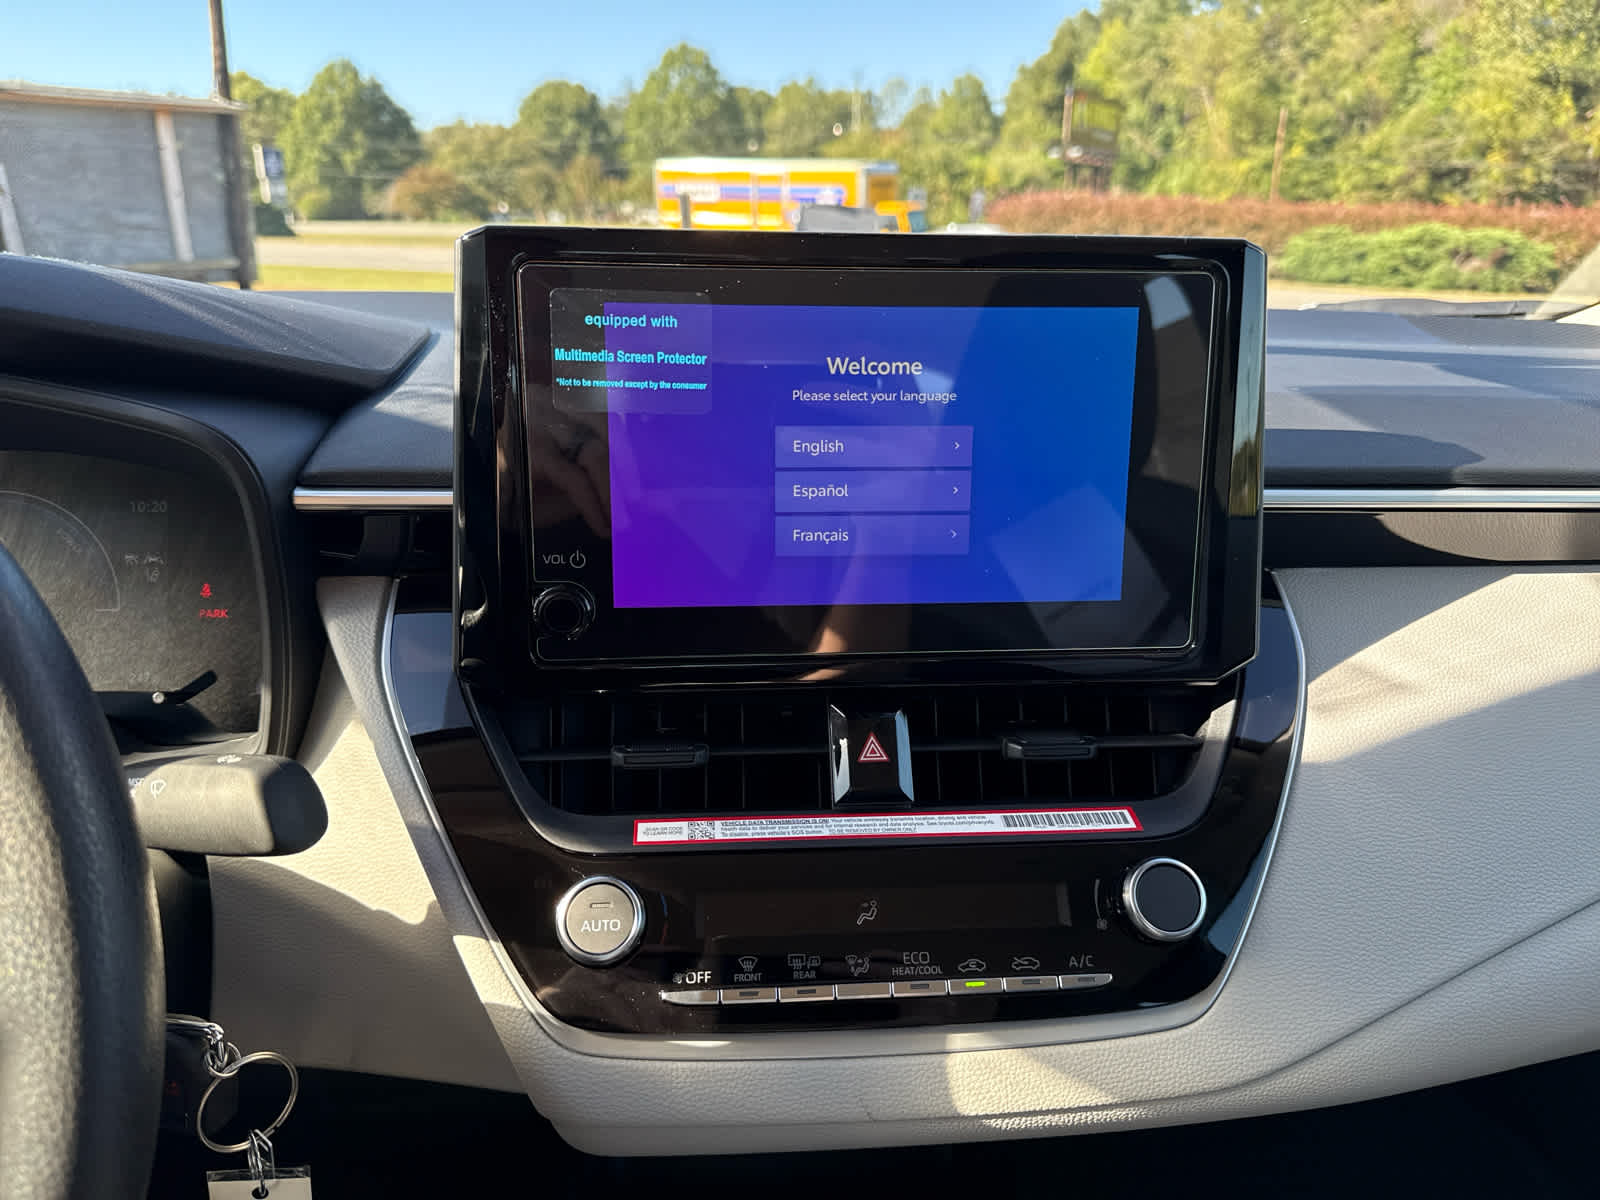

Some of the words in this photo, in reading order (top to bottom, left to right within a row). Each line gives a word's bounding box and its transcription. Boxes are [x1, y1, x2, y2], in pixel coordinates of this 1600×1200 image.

[585, 314, 646, 328] equipped
[650, 315, 678, 328] with
[554, 348, 614, 362] Multimedia
[617, 350, 654, 363] Screen
[657, 352, 707, 365] Protector
[826, 356, 923, 375] Welcome
[573, 379, 581, 387] to
[582, 378, 591, 387] be
[592, 379, 623, 387] removed
[625, 380, 648, 389] except
[649, 380, 658, 390] by
[660, 381, 671, 389] the
[672, 382, 707, 390] consumer
[792, 389, 831, 401] Please
[833, 390, 867, 401] select
[870, 392, 897, 404] your
[900, 390, 957, 404] language
[793, 439, 844, 456] English
[793, 483, 848, 499] Español
[129, 500, 168, 512] 10:20
[792, 528, 849, 544] Français
[543, 553, 567, 564] VOL
[199, 608, 228, 618] PARK
[580, 919, 621, 932] AUTO
[903, 951, 930, 965] ECO
[1068, 955, 1094, 968] A/C
[685, 971, 712, 984] OFF
[734, 973, 762, 982] FRONT
[793, 971, 816, 979] REAR
[892, 966, 943, 976] HEAT/COOL
